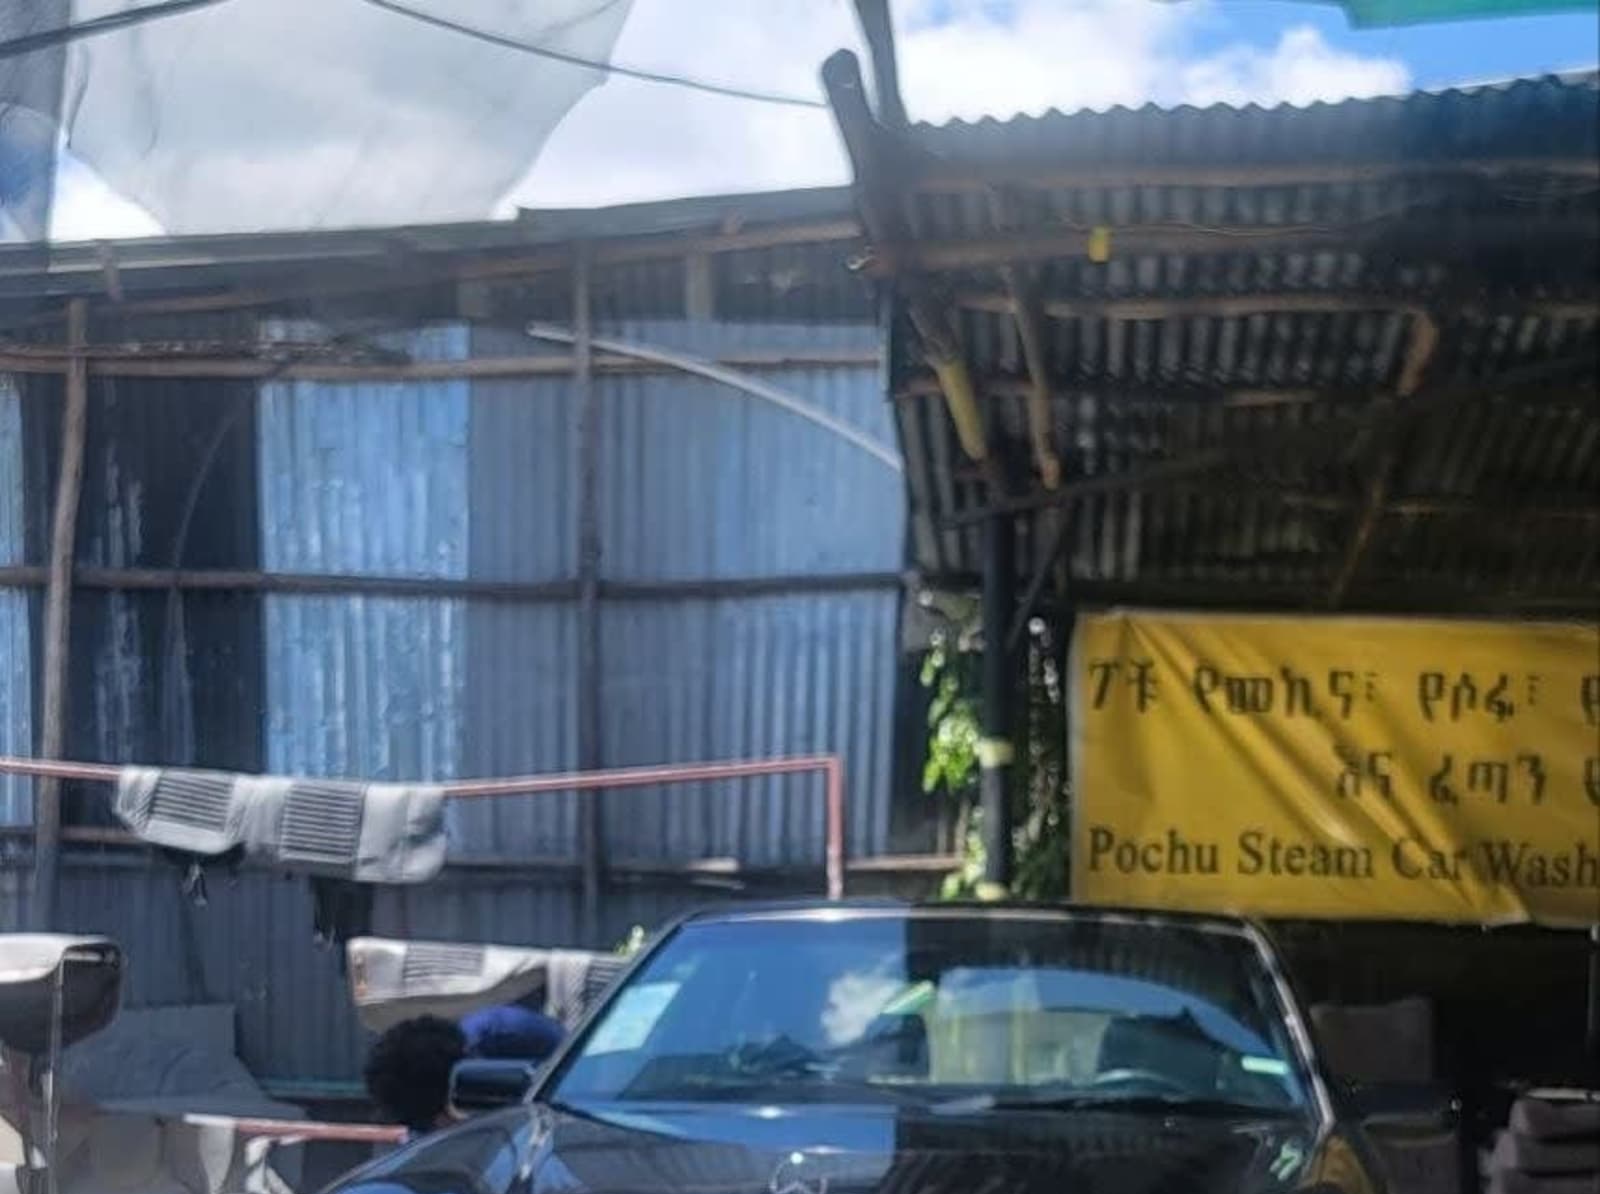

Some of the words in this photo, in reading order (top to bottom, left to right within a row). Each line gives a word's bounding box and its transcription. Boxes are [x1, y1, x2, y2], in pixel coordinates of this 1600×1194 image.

[1089, 829, 1218, 875] Pochu
[1237, 832, 1374, 879] Steam
[1392, 835, 1466, 882] Car
[1483, 841, 1599, 888] Wash
